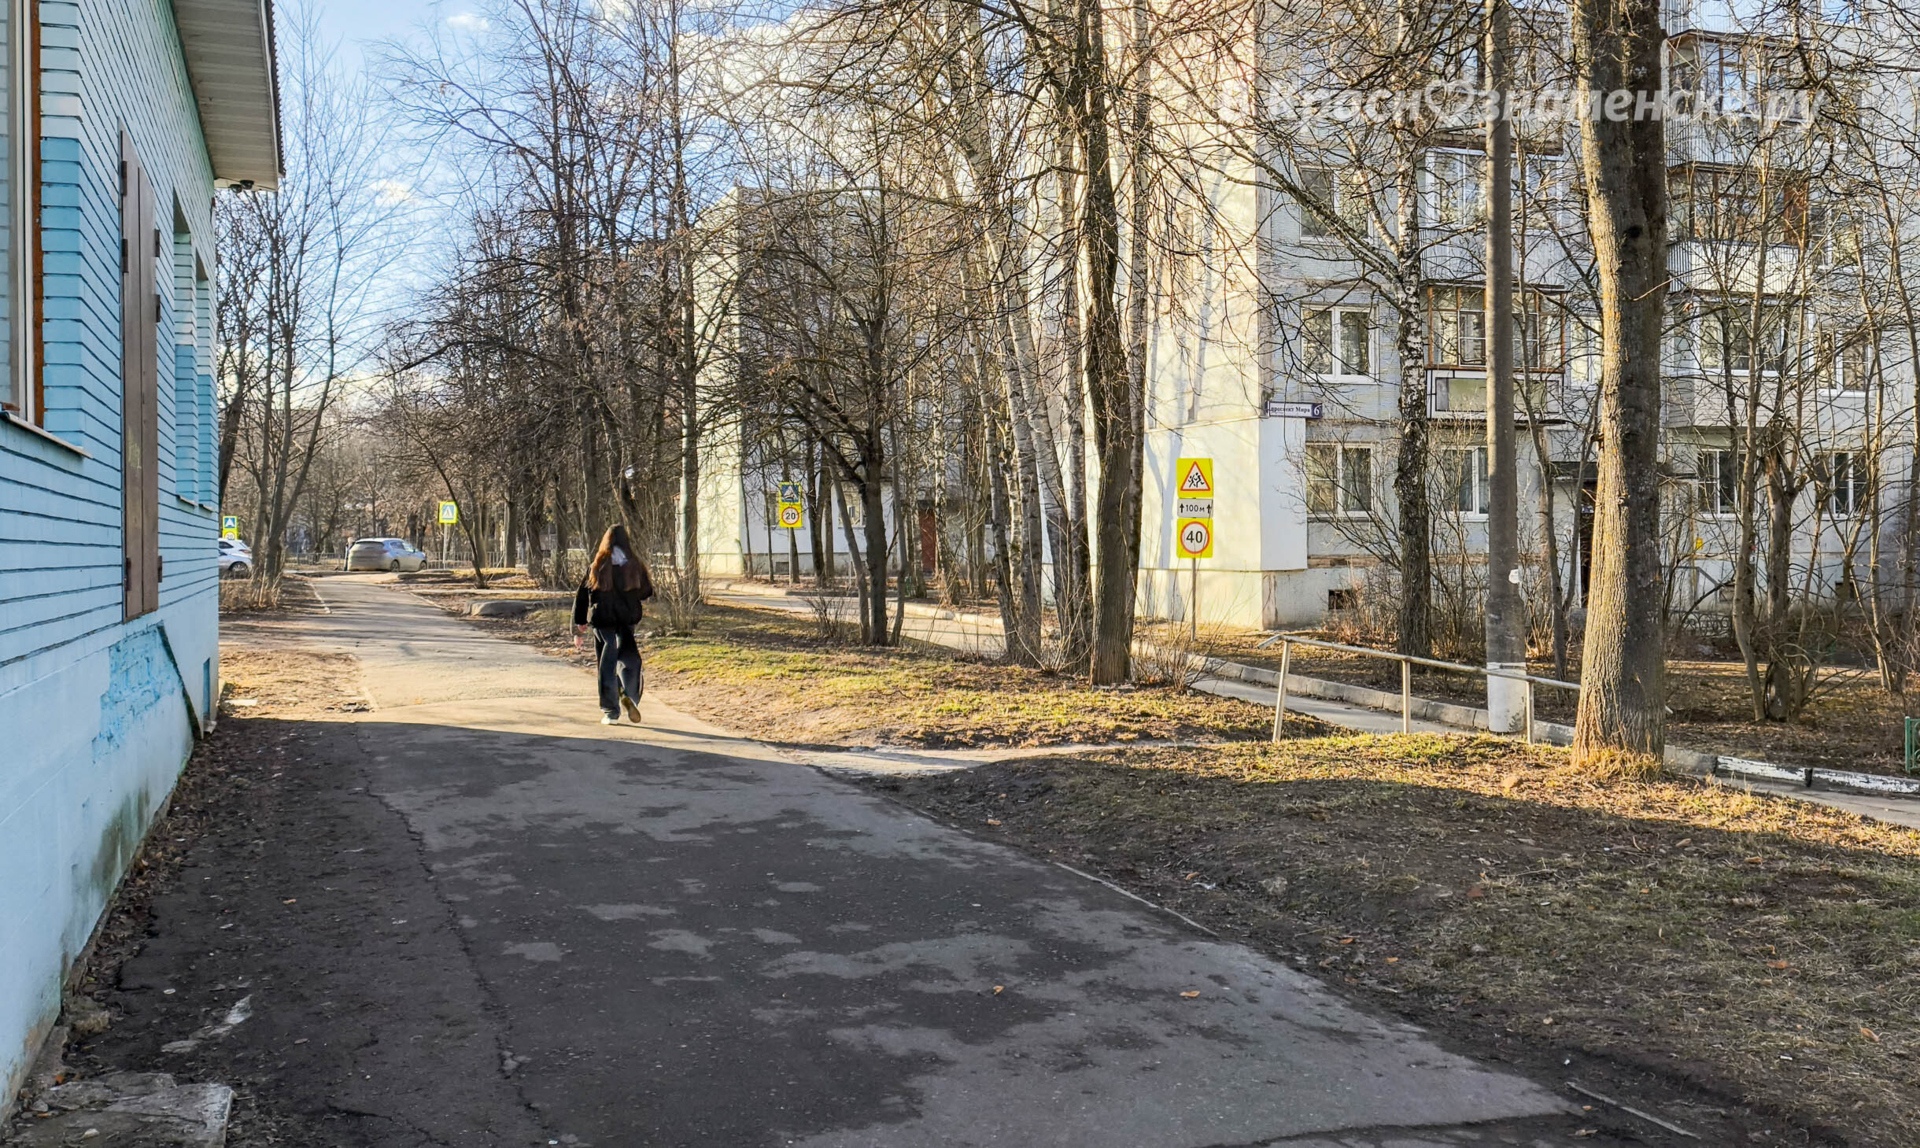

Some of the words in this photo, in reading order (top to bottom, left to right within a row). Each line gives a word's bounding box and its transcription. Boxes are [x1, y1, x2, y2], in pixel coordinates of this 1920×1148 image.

[1313, 404, 1322, 416] 6
[785, 512, 796, 520] 20
[1186, 530, 1203, 543] 40
